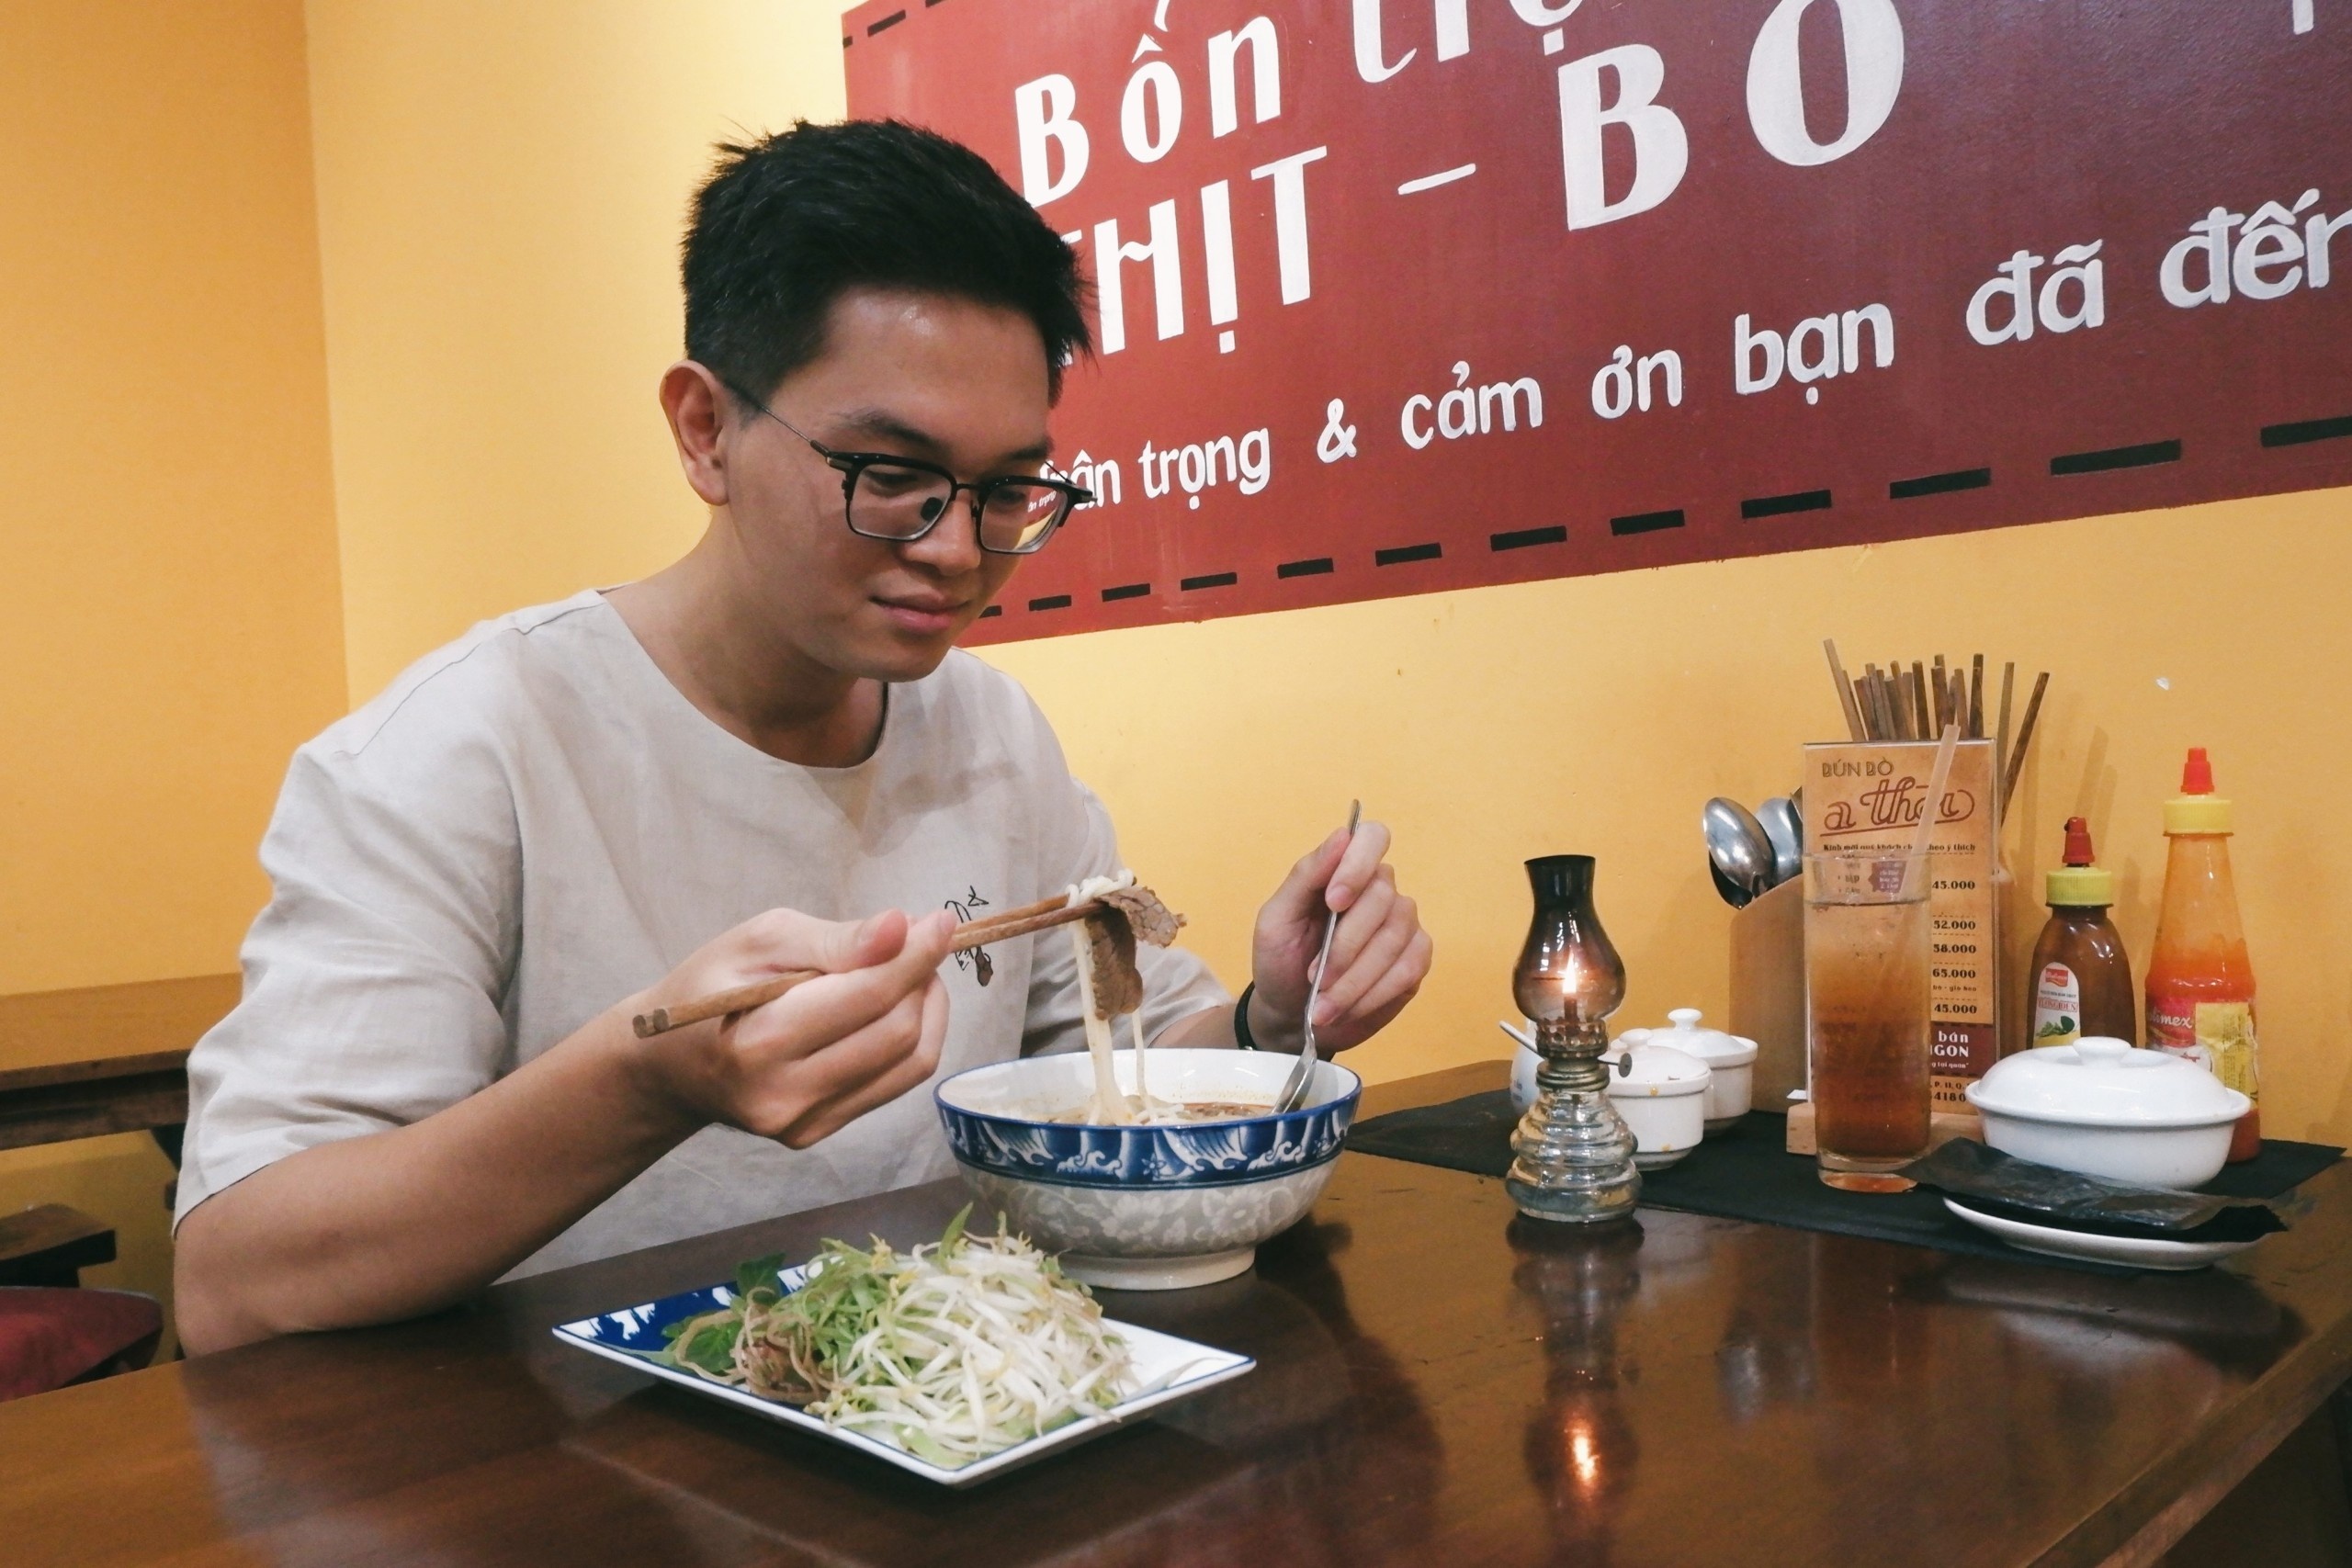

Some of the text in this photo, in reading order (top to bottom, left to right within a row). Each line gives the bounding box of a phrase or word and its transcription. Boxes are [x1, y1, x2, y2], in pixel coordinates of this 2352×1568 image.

[1059, 145, 1328, 366] HỊT
[1138, 427, 1271, 510] trọng
[1317, 398, 1357, 463] &
[1401, 361, 1543, 449] cảm
[1735, 303, 1894, 405] bạn
[1966, 239, 2105, 346] đã
[1822, 756, 1894, 777] BÚN BÒ
[1927, 843, 1945, 852] heo
[1931, 880, 1975, 890] 45.000
[1933, 919, 1976, 931] 52.000
[1933, 943, 1977, 954] 58.000
[1932, 968, 1976, 979] 65.000
[1933, 1003, 1977, 1014] 45.000
[1938, 1030, 1969, 1043] bán
